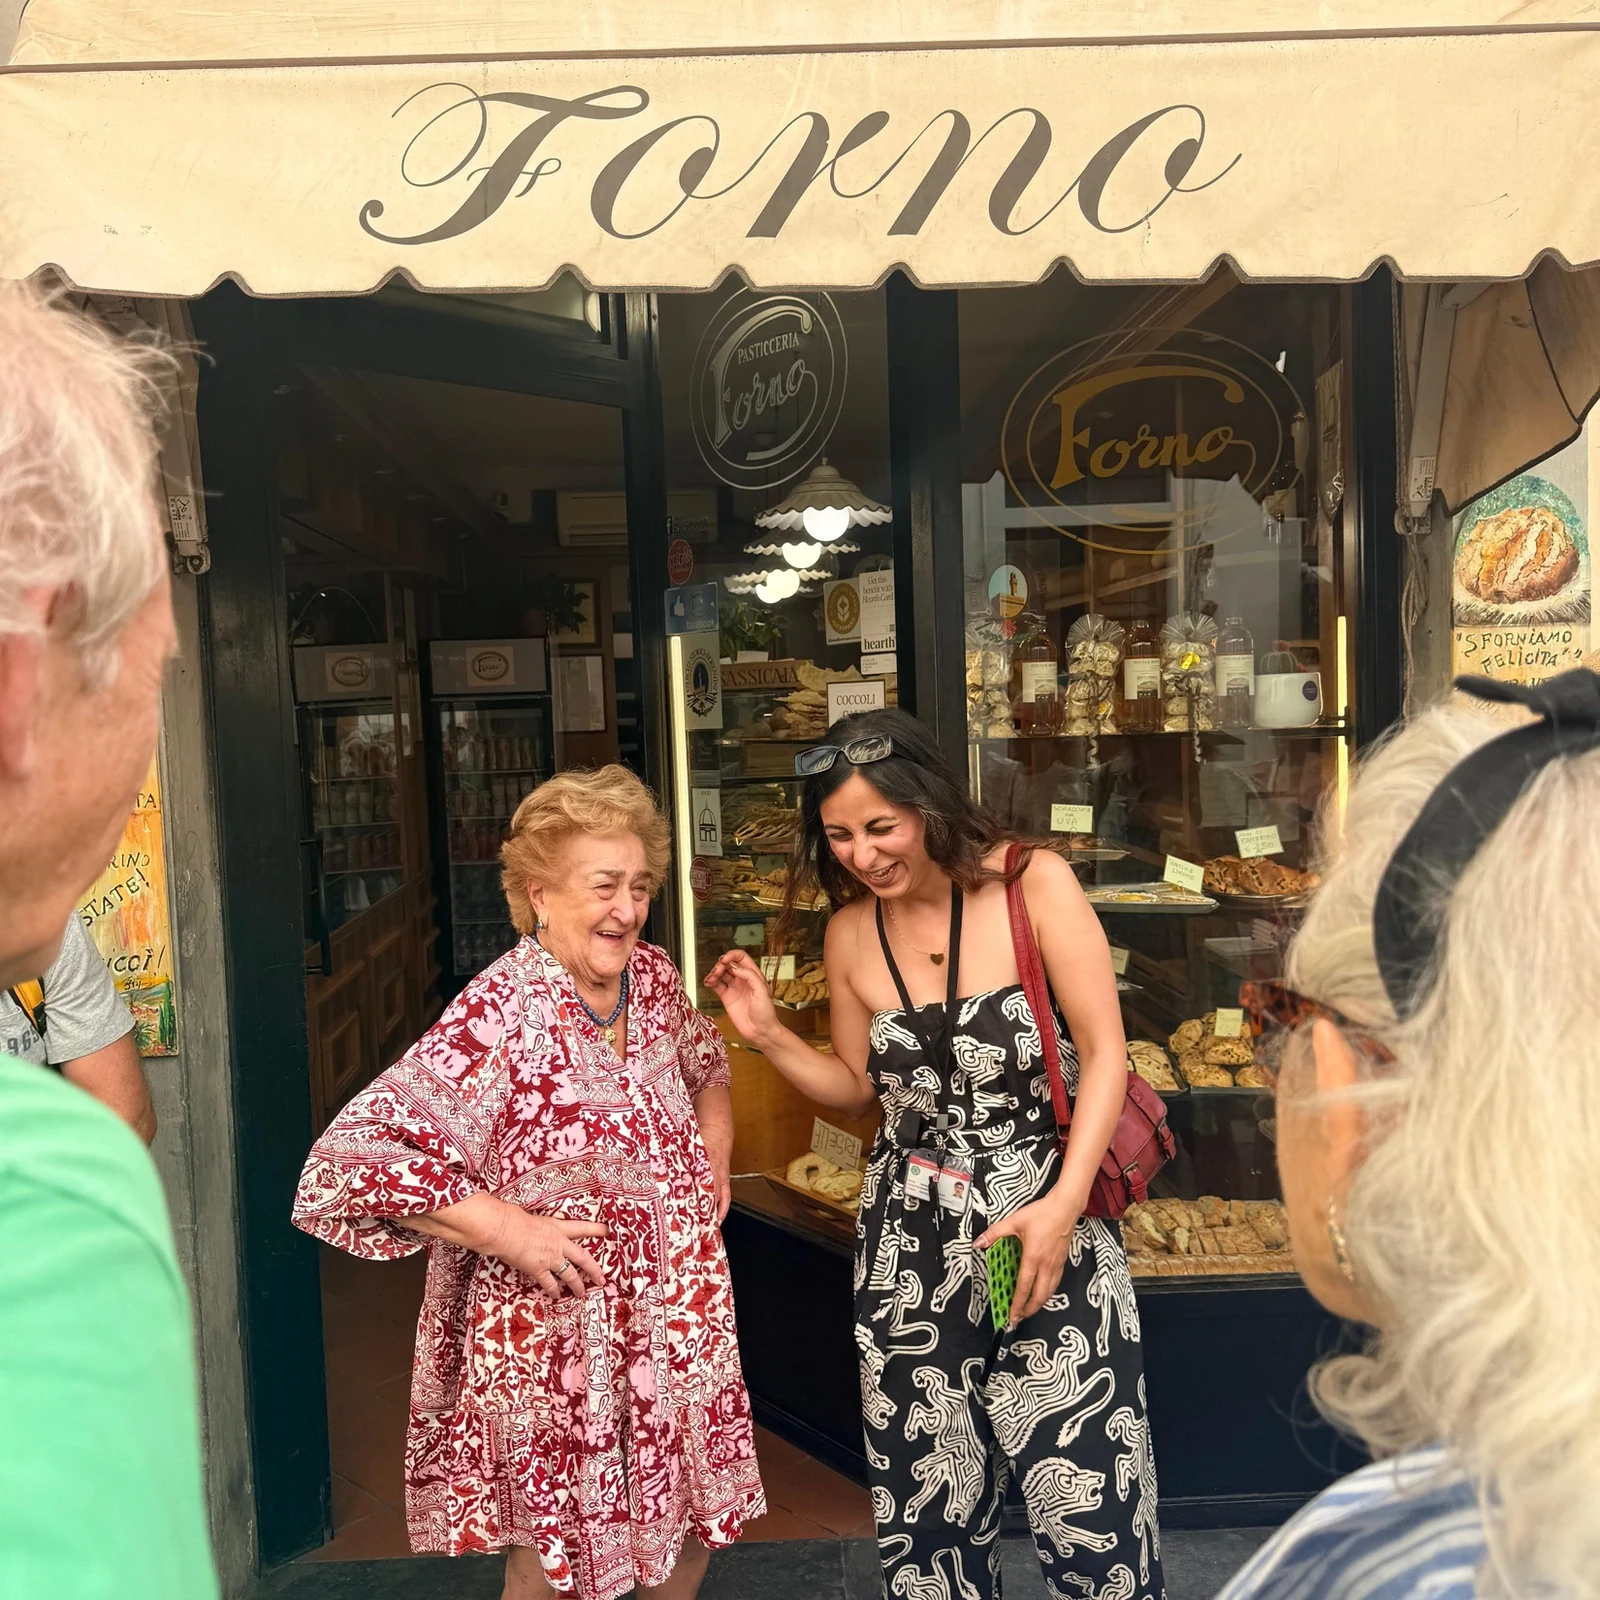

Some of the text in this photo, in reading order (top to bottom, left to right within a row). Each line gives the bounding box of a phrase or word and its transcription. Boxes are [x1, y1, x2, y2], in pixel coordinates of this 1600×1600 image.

[357, 82, 1243, 246] Forno
[737, 331, 800, 365] PASTICCERIA
[709, 304, 818, 461] Forno
[1050, 364, 1257, 492] Forno
[863, 636, 895, 650] hearth
[836, 693, 876, 706] COCCOLI
[1056, 817, 1078, 826] UVA
